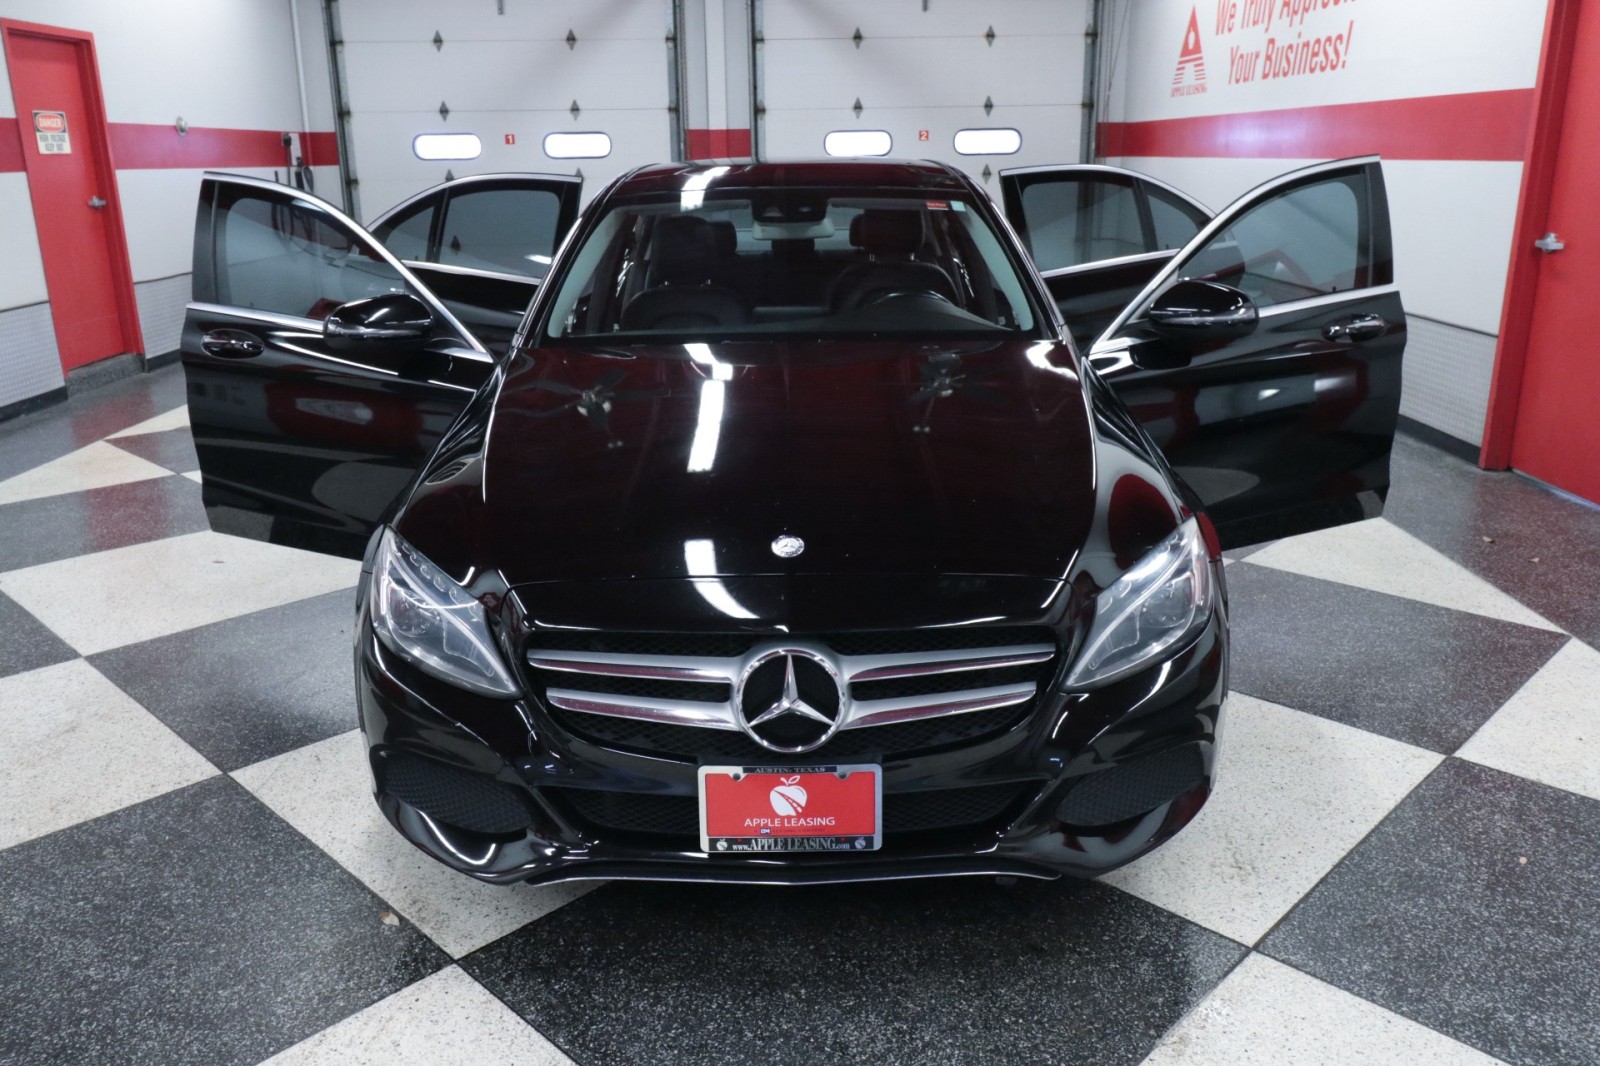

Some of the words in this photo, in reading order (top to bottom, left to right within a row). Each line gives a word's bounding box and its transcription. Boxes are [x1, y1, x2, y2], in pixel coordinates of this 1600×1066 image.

[1216, 0, 1236, 36] We
[1229, 45, 1260, 85] Your
[1261, 20, 1354, 80] Business!
[38, 117, 62, 128] DANGER
[920, 131, 928, 140] 2
[744, 818, 781, 827] APPLE
[784, 816, 836, 827] LEASING
